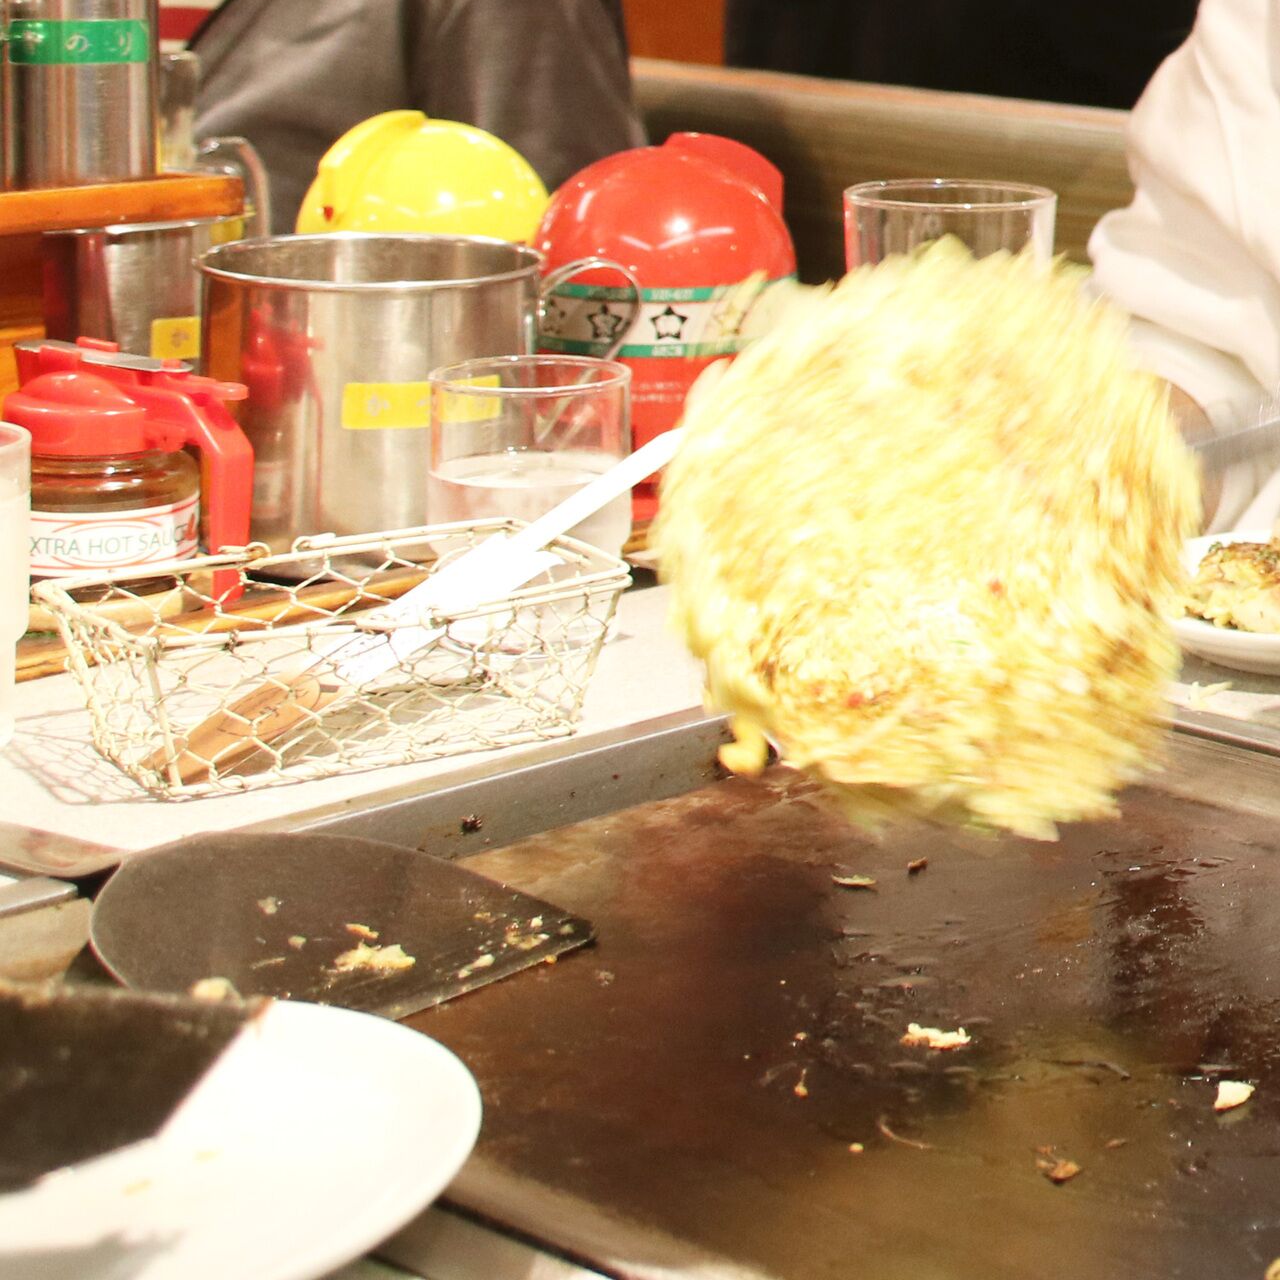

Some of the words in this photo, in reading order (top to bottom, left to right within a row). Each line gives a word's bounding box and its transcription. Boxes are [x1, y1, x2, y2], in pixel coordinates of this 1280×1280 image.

[29, 536, 81, 556] XTRA
[88, 535, 133, 555] HOT
[138, 522, 188, 553] SAUC
